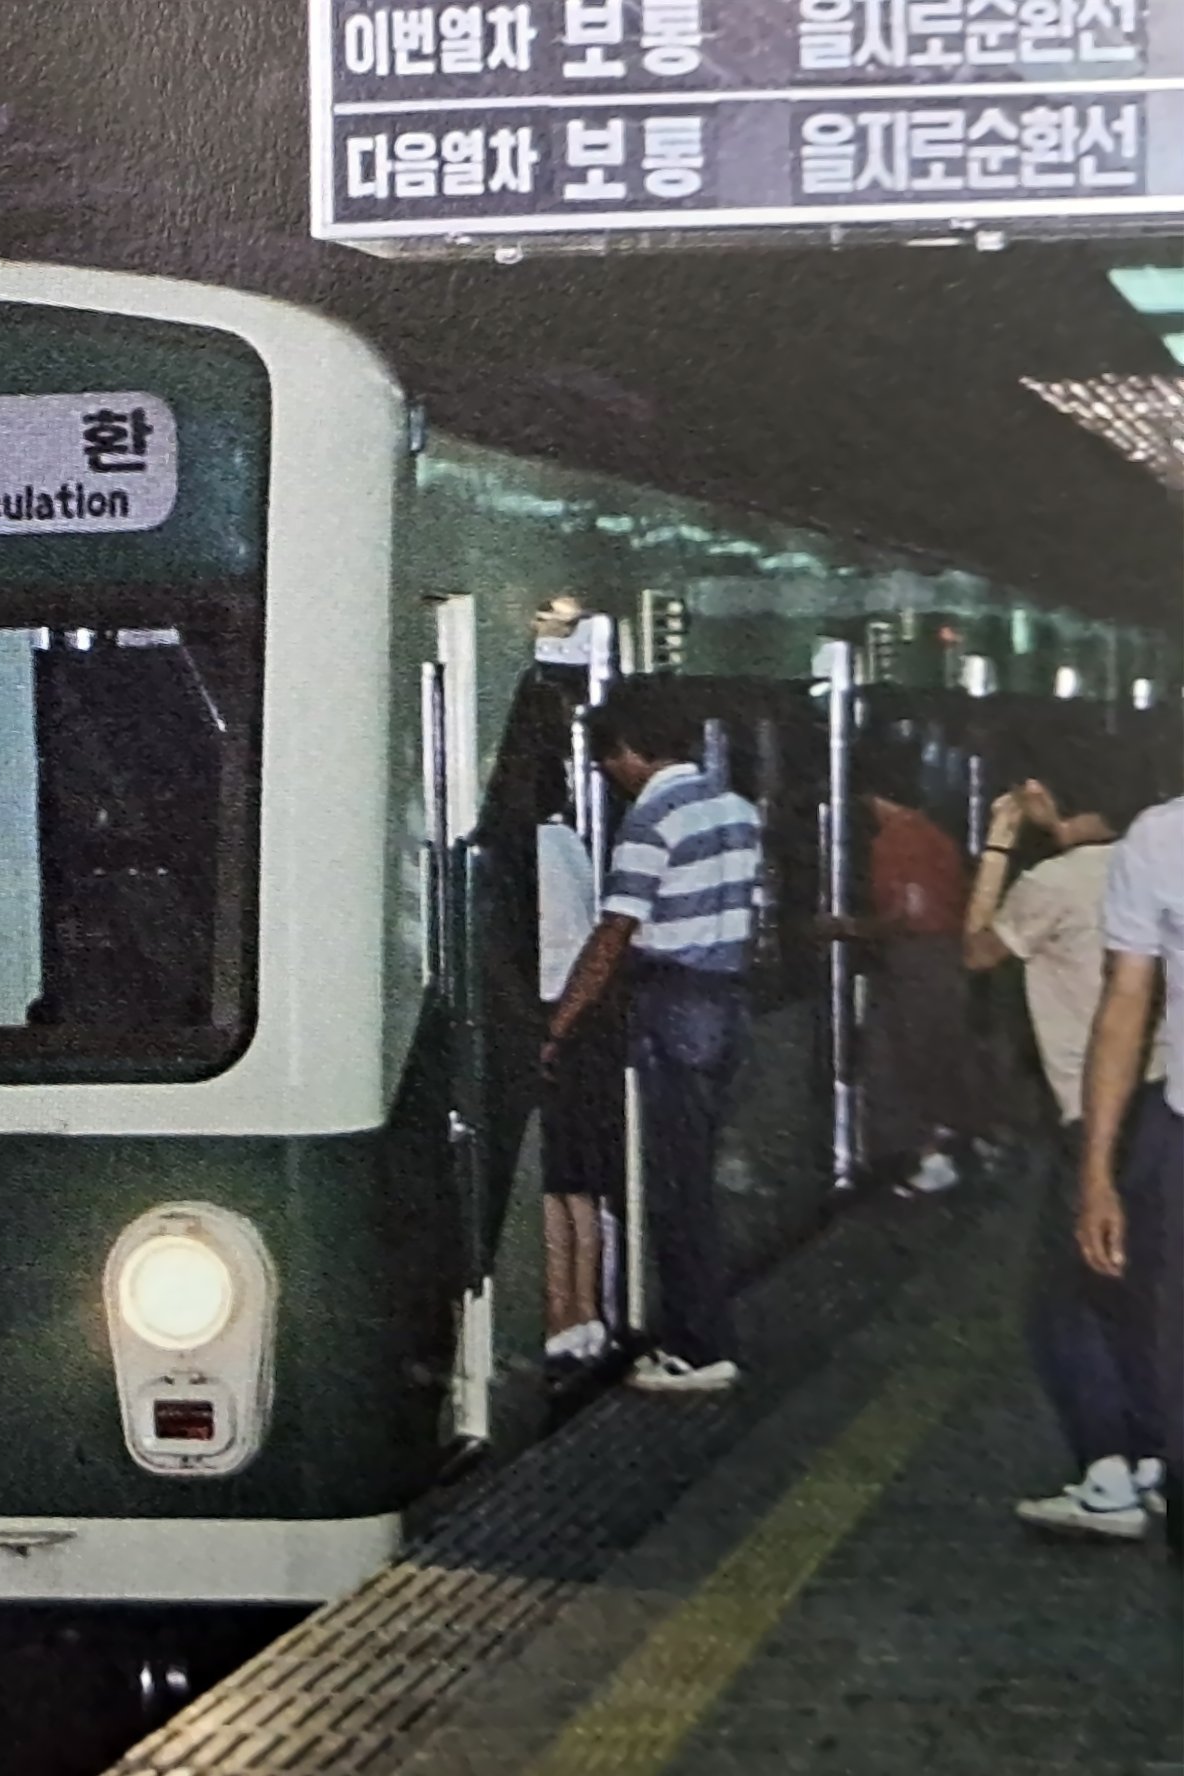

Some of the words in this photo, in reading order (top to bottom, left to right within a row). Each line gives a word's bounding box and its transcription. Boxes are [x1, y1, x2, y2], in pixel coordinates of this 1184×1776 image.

[344, 5, 537, 77] 이번열차
[562, 0, 703, 78] 보통
[798, 0, 1138, 70] 을지로순환선
[346, 126, 539, 199] 다음열차
[563, 117, 704, 200] 보통
[800, 104, 1138, 194] 을지로순환선
